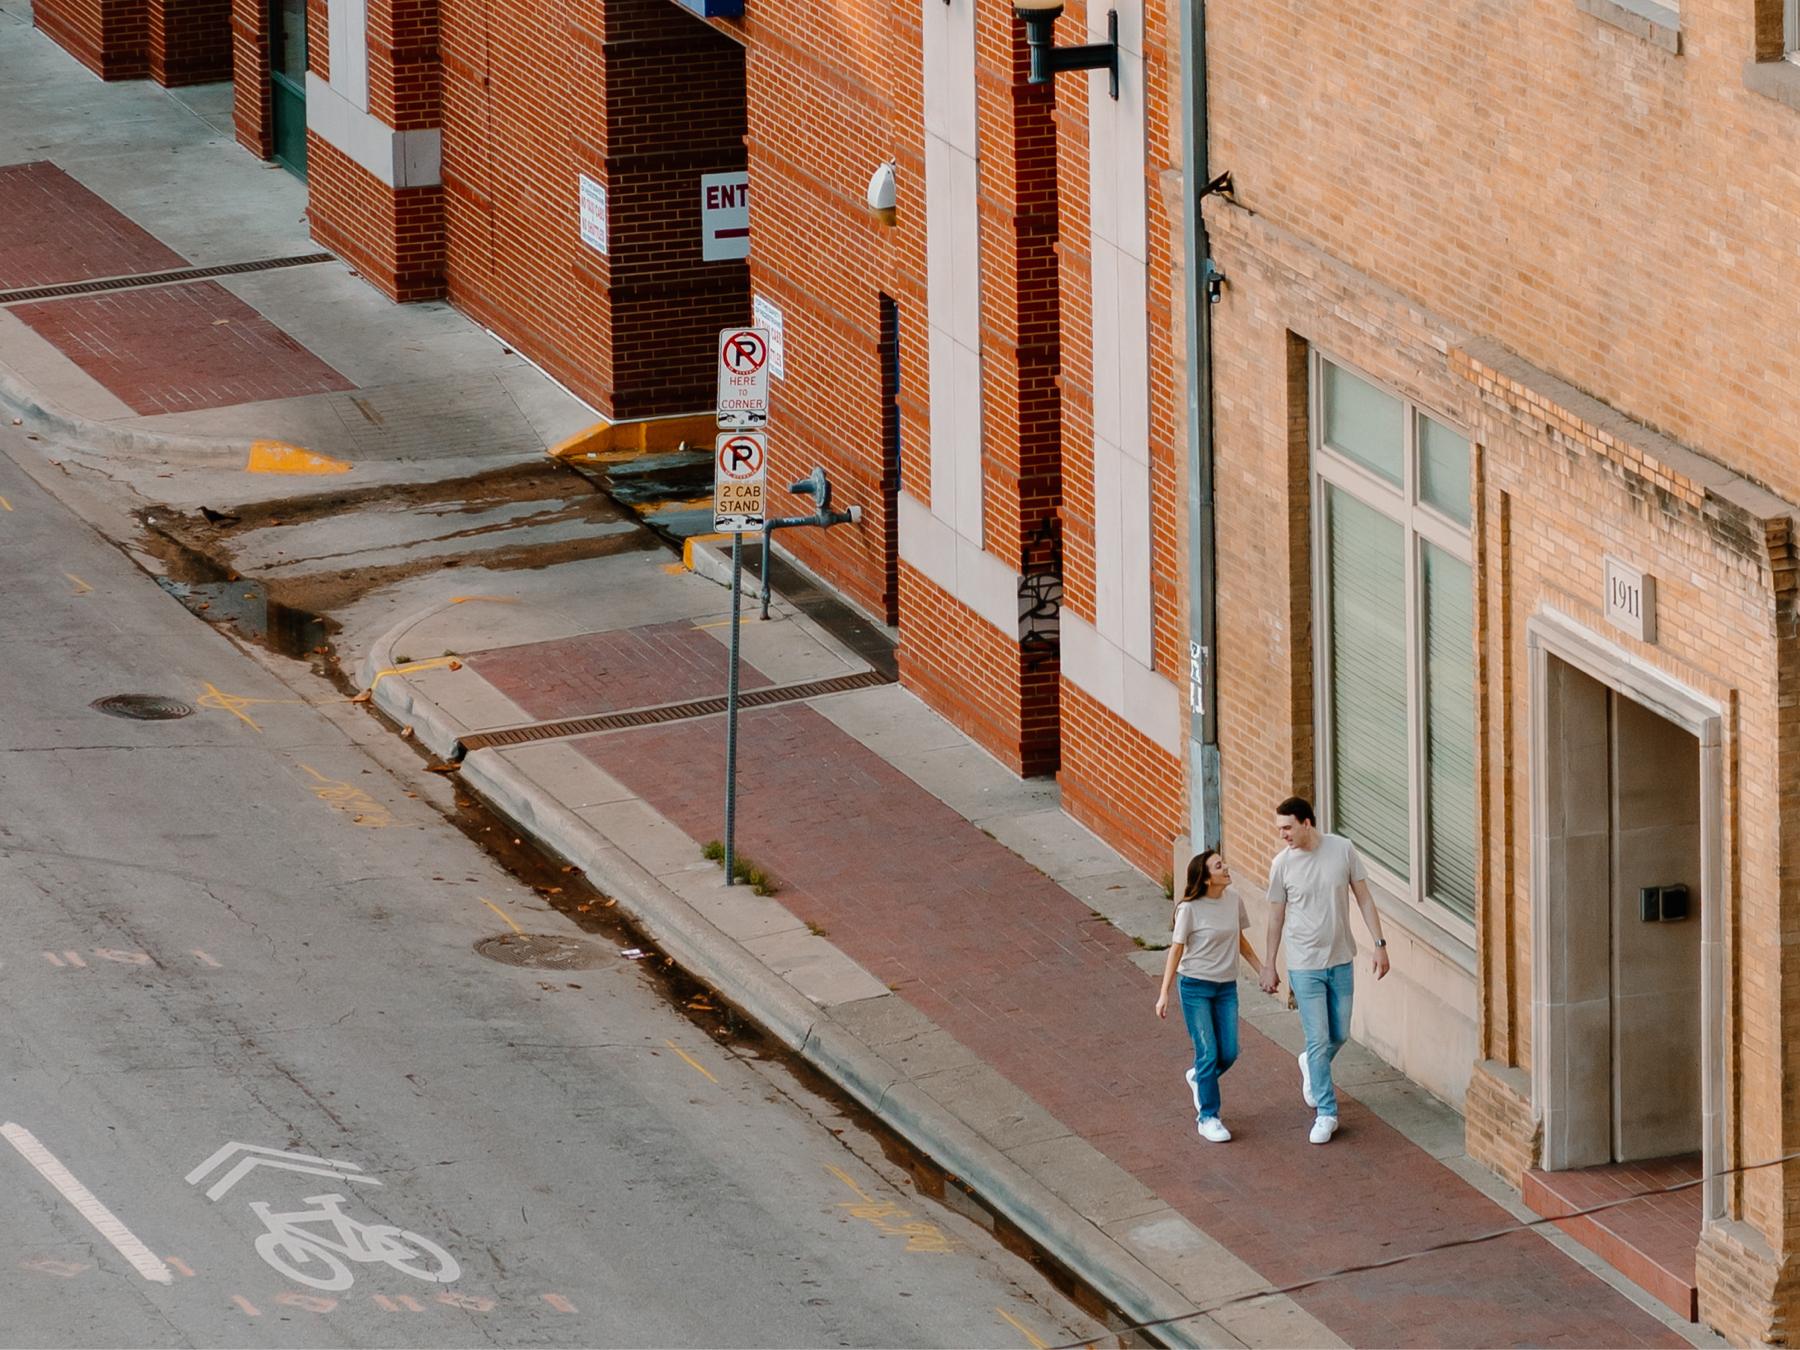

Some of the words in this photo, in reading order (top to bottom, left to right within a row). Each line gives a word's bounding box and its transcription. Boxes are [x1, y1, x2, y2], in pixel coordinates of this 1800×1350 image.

[706, 183, 749, 210] ENT
[729, 376, 757, 386] HERE
[738, 388, 749, 397] TO
[721, 399, 763, 409] CORNER
[723, 485, 731, 498] 2
[735, 485, 761, 498] CAB
[720, 500, 760, 512] STAND
[1612, 576, 1641, 620] 1911
